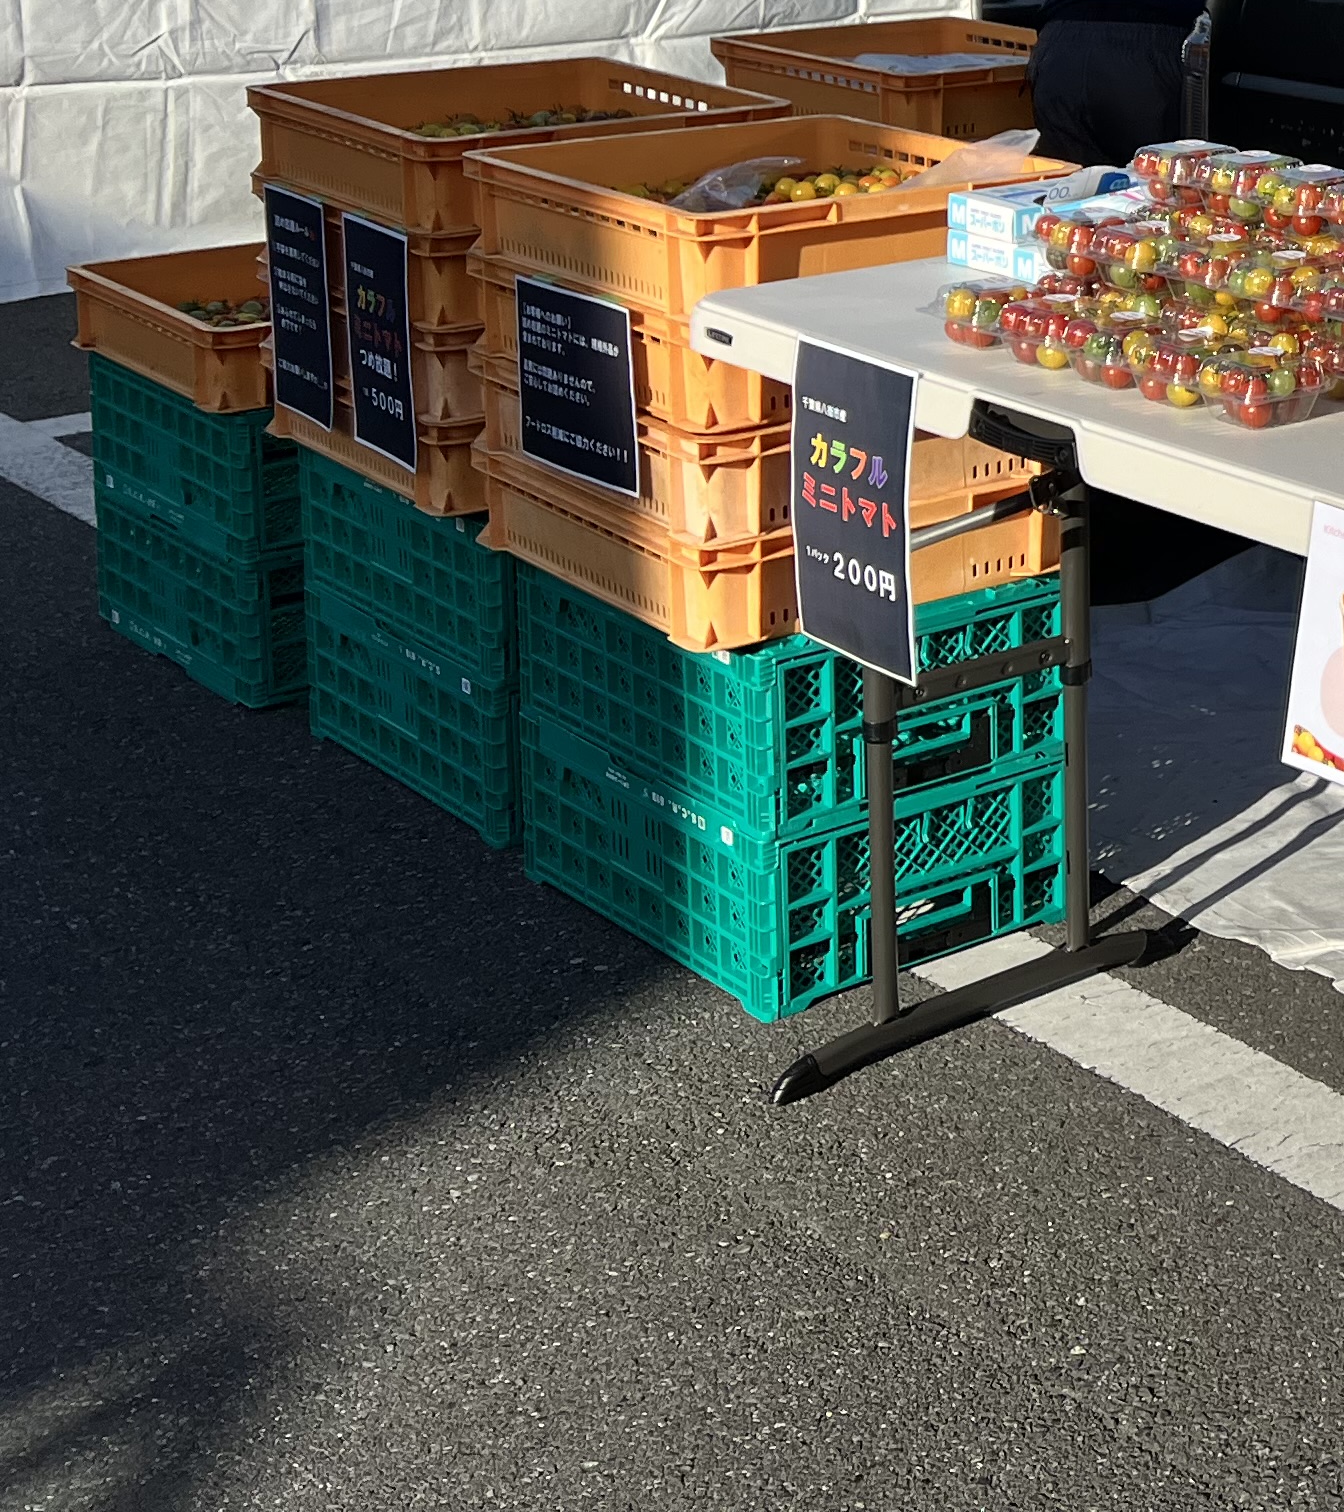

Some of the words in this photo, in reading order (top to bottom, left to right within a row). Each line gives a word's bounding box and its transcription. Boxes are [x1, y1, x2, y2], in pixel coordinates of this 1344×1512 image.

[356, 284, 396, 322] カラフル
[810, 432, 888, 489] カラフル
[801, 471, 897, 538] ミニトマト
[832, 551, 897, 603] 200円
